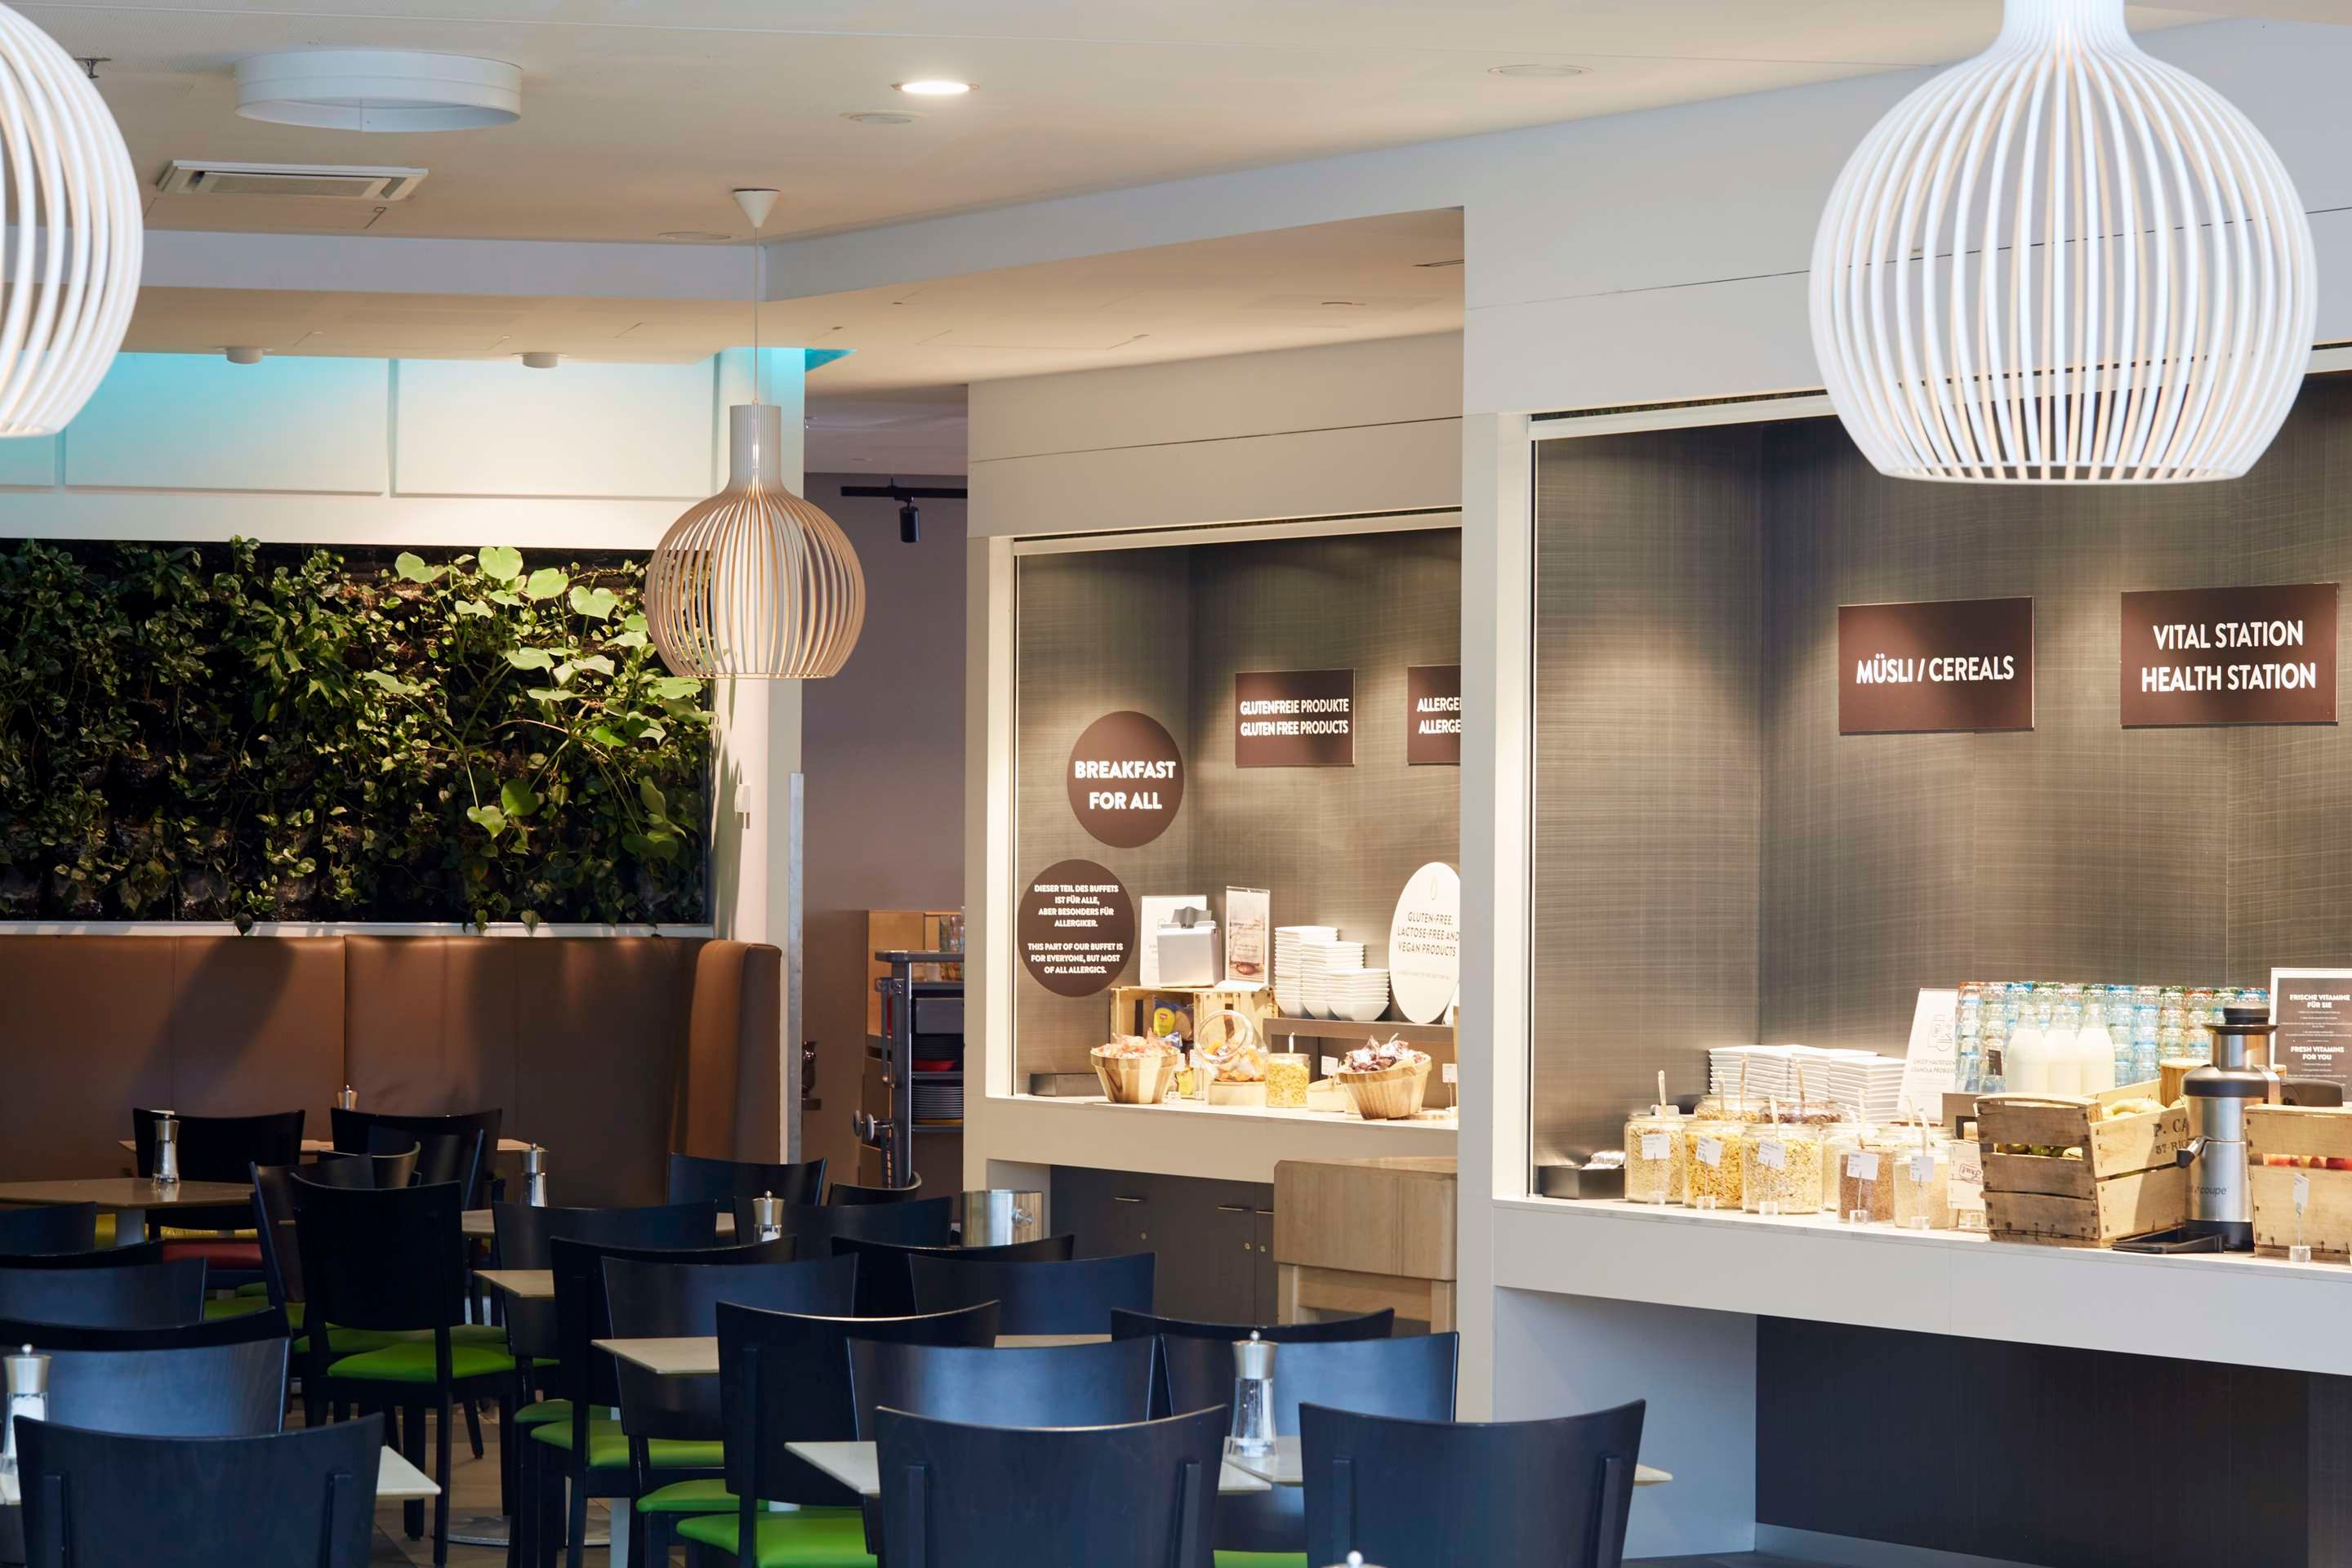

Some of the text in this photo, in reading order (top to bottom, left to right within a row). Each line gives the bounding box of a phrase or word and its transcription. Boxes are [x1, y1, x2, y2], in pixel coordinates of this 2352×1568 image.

[2153, 620, 2303, 650] VITAL STATION
[1855, 653, 2015, 684] MÜSLI / CEREALS
[2141, 662, 2316, 693] HEALTH STATION
[1241, 698, 1349, 715] GLUTENFREIE PRODUKTE
[1417, 697, 1461, 712] ALLERGE
[1241, 719, 1348, 736] GLUTEN FREE PRODUCTS
[1075, 760, 1176, 778] BREAKFAST
[1089, 791, 1162, 809] FOR ALL
[1034, 884, 1119, 893] DIESER TEIL DES BUFFETS
[1055, 895, 1100, 906] IST FÜR ALLE,
[1099, 906, 1114, 915] FÜR
[1397, 927, 1445, 940] LACTOSE-FREE
[1027, 942, 1124, 951] THIS PART OF OUR BUFFET IS
[1397, 941, 1457, 957] VEGAN PRODUCTS
[1046, 955, 1086, 963] EVERYONE,
